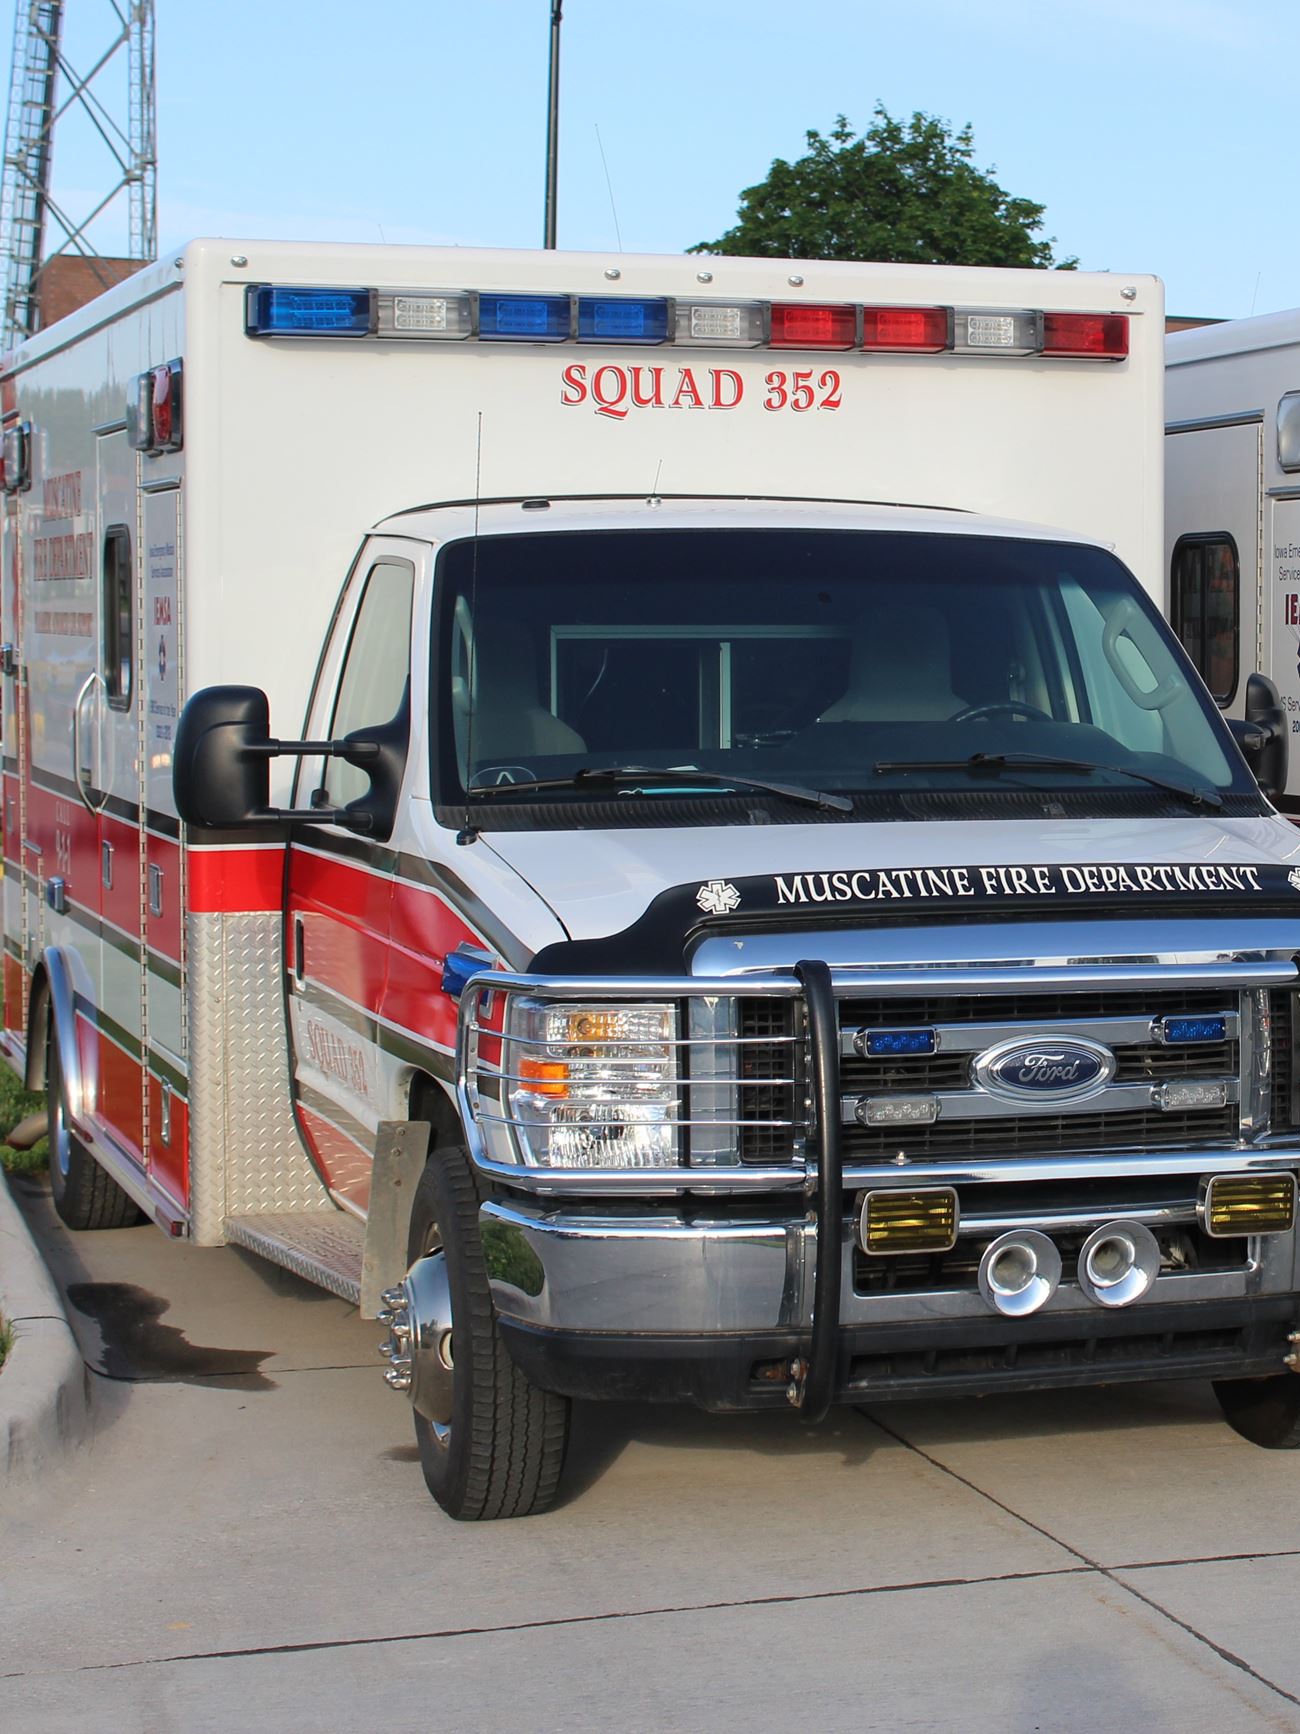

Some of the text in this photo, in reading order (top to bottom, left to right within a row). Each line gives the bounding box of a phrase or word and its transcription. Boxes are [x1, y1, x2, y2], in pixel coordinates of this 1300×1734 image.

[561, 364, 843, 420] SQUAD 352
[774, 866, 1262, 904] MUSCATINE FIRE DEPARTMENT
[1018, 1055, 1080, 1082] Ford
